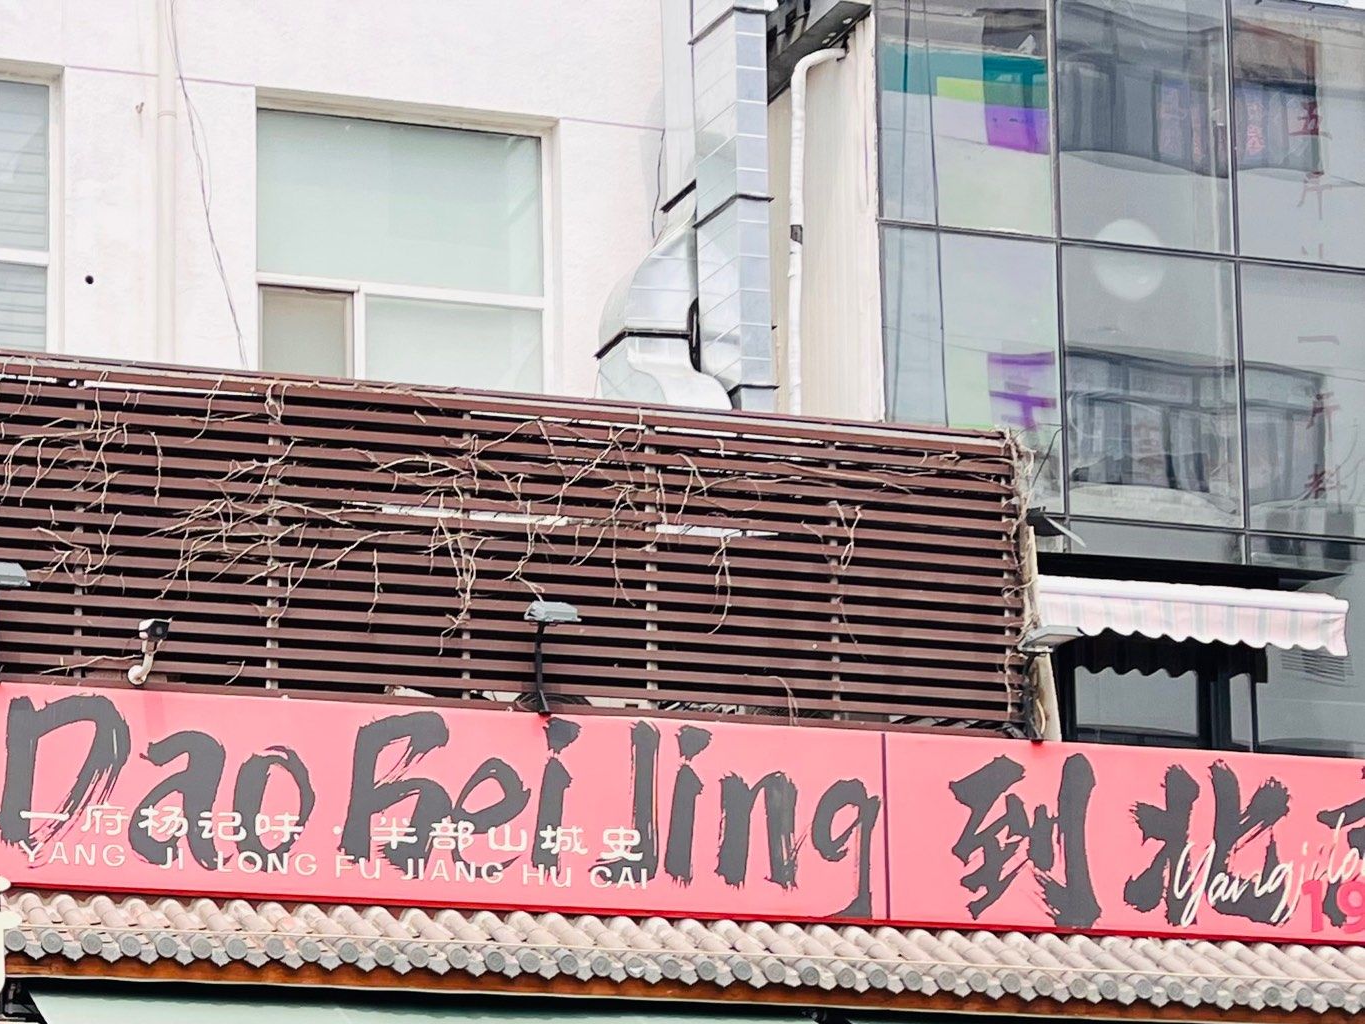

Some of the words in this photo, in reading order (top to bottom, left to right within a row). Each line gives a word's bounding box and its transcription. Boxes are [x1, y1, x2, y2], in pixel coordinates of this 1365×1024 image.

[20, 841, 127, 868] YANG
[159, 845, 186, 872] JI
[216, 849, 318, 877] LONG
[335, 854, 383, 881] FU
[401, 857, 504, 885] JIANG
[522, 863, 572, 889] HU
[589, 865, 648, 891] CAI
